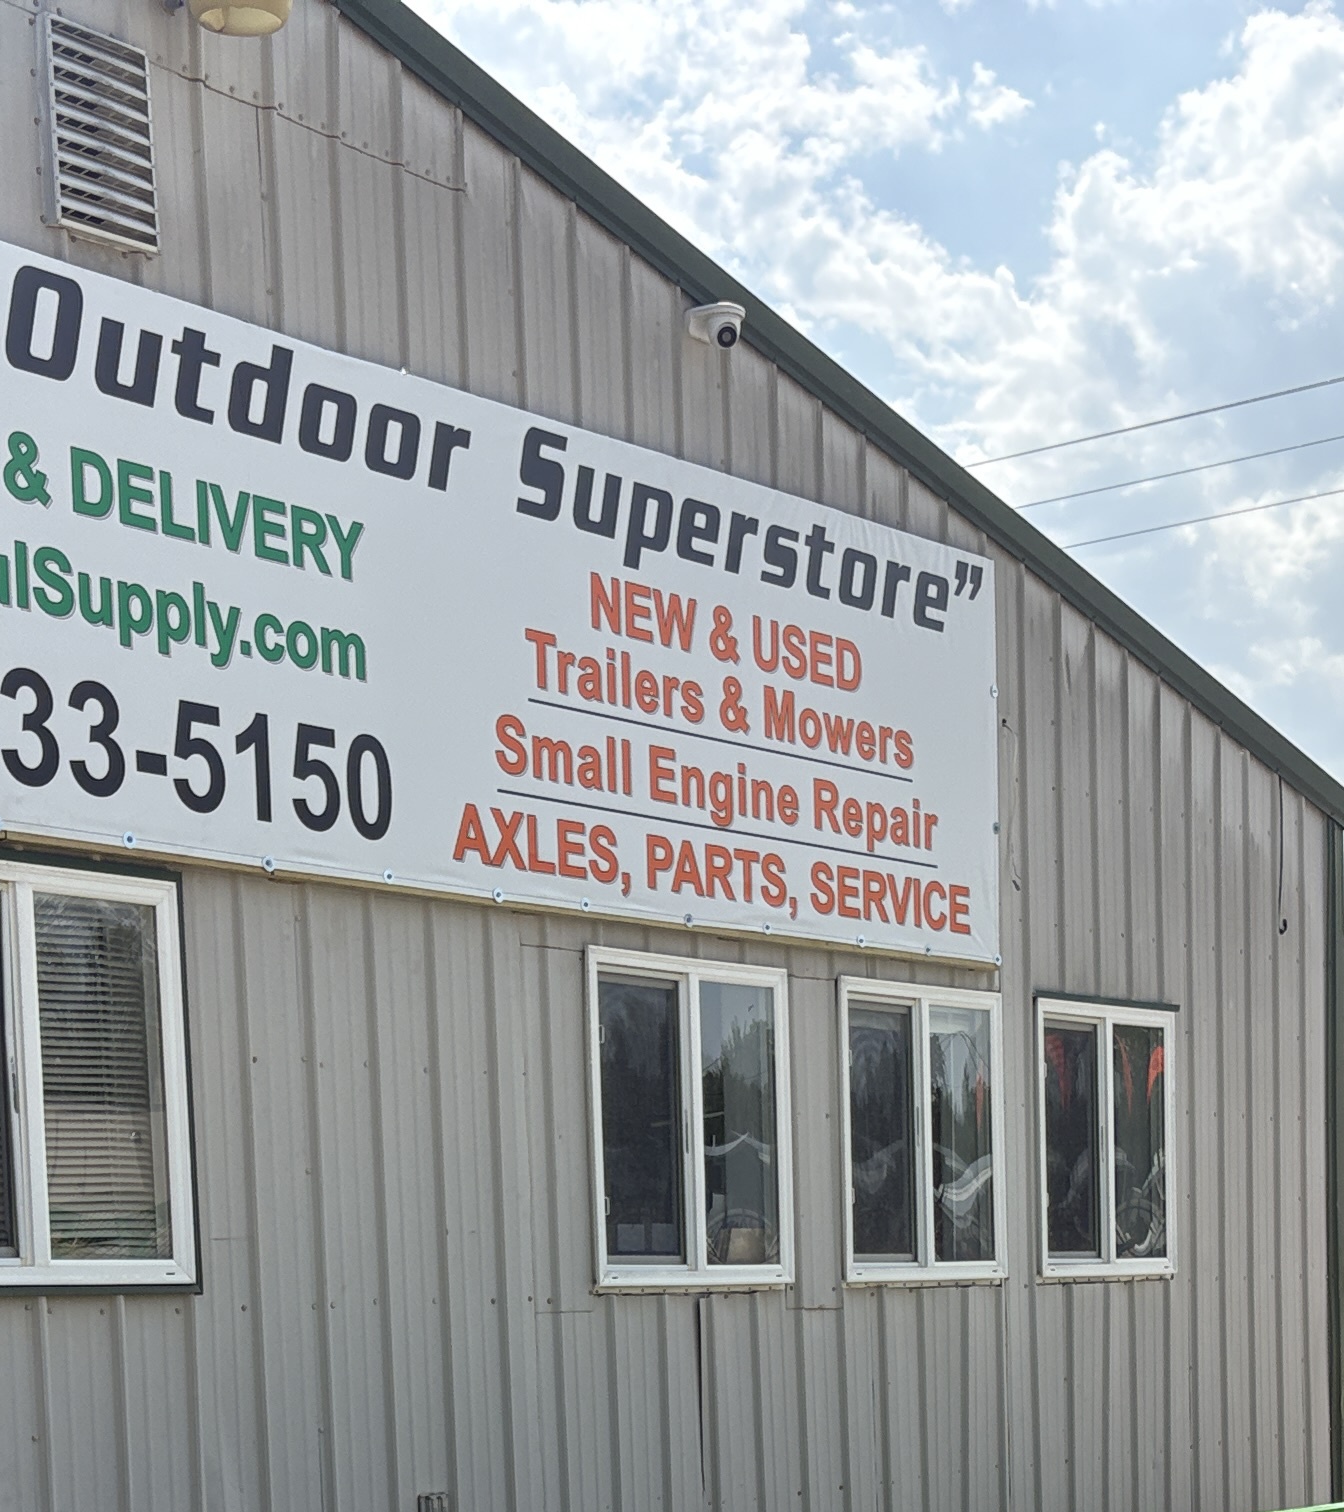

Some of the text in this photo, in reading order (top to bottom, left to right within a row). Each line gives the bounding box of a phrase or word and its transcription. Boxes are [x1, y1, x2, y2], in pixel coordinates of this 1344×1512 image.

[5, 264, 471, 492] Outdoor
[3, 430, 52, 508] &
[70, 445, 365, 582] DELIVERY
[524, 627, 914, 770] Trailers & Mowers
[590, 571, 863, 692] NEW & USED
[495, 714, 939, 853] Small Engine Repair
[453, 803, 972, 936] AXLES, PARTS, SERVICE
